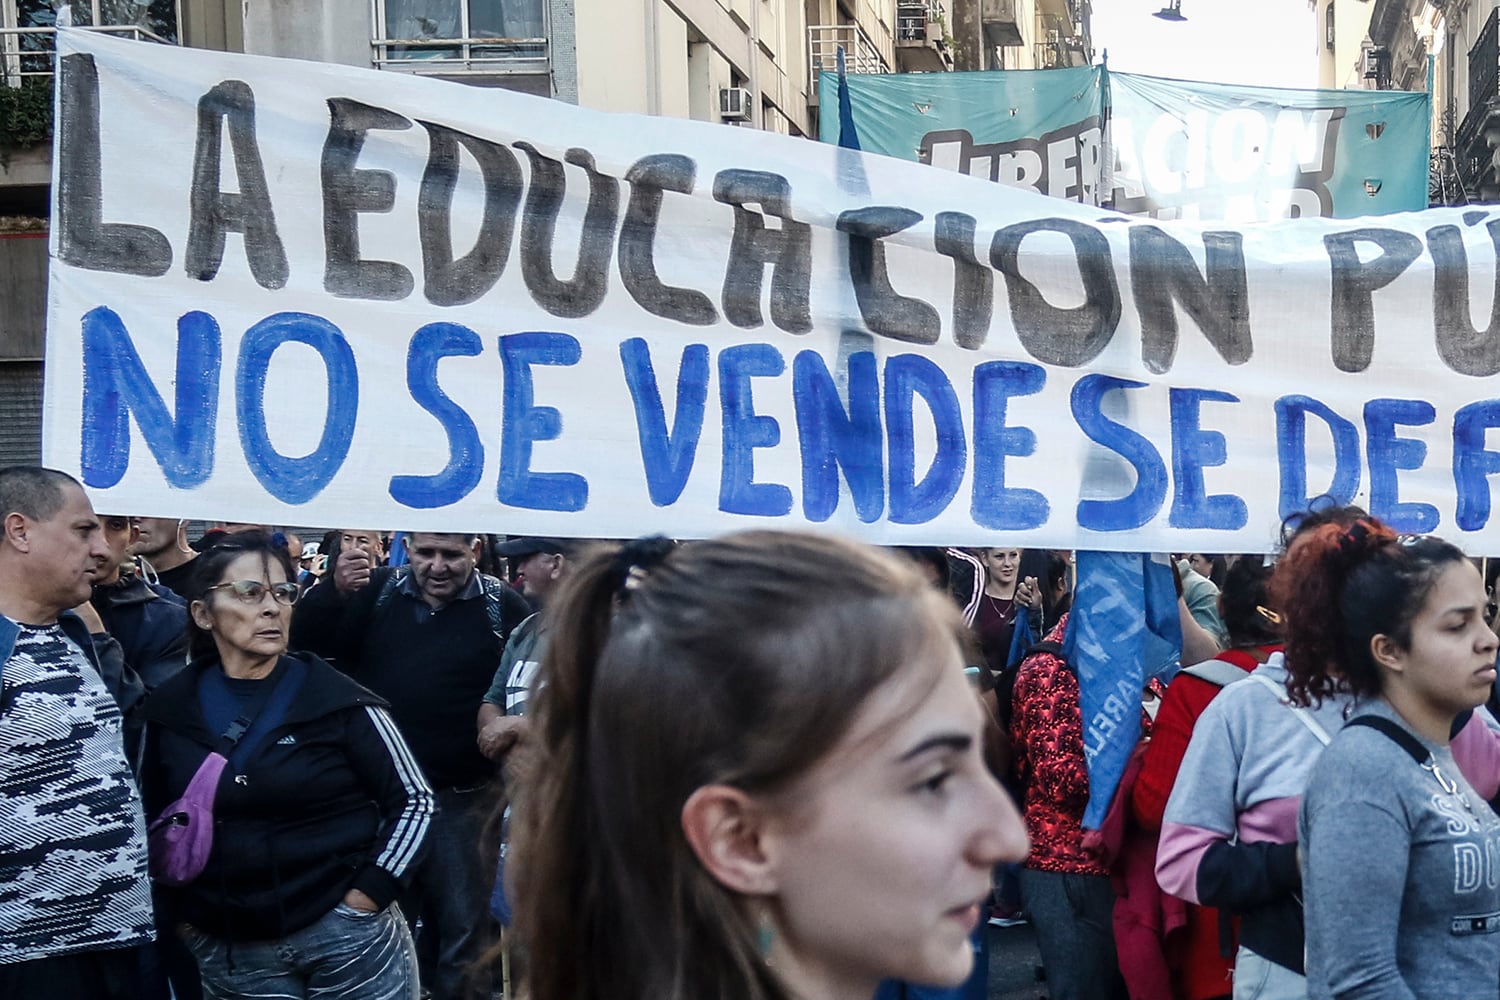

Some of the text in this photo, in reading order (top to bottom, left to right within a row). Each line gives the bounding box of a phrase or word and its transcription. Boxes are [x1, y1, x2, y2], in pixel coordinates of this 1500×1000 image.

[59, 52, 289, 290] LA
[81, 305, 359, 505] NO
[389, 322, 589, 512] SE
[619, 337, 1050, 531] VENDE
[1070, 373, 1248, 532] SE
